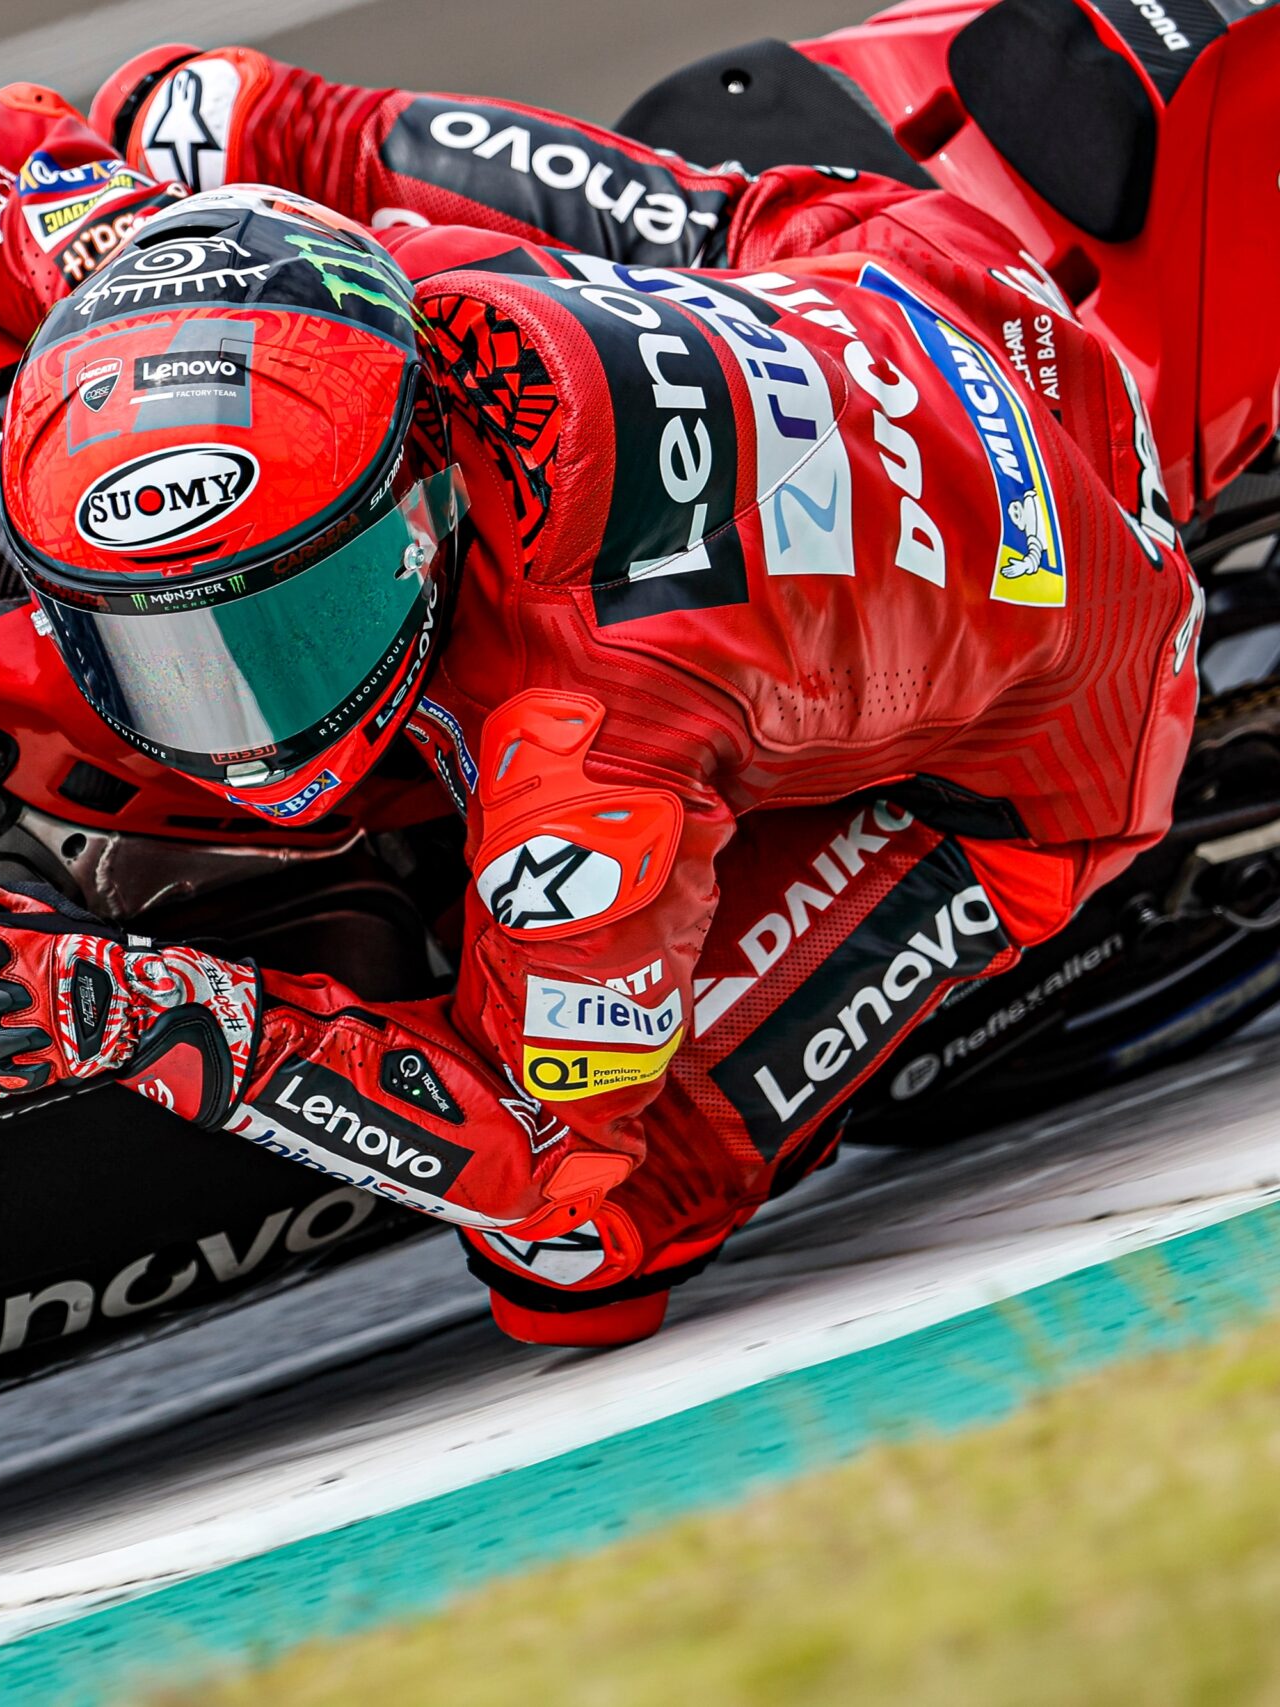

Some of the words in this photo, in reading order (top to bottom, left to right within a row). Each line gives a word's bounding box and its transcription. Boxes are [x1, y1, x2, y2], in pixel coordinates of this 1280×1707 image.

[1033, 314, 1057, 360] BAG
[80, 361, 119, 382] DUCATI
[142, 360, 237, 381] Lenovo
[1038, 364, 1061, 400] AIR
[85, 384, 111, 401] CORSE
[175, 389, 214, 399] FACTORY
[214, 389, 237, 398] TEAM
[369, 444, 405, 512] SUOMY
[87, 471, 240, 525] SUOMY
[164, 598, 215, 611] ENERGY
[577, 994, 674, 1037] riello
[753, 884, 999, 1123] Lenovo
[528, 1056, 589, 1091] Q1
[593, 1067, 642, 1078] Premium
[593, 1074, 638, 1087] Masking
[275, 1075, 442, 1179] Lenovo
